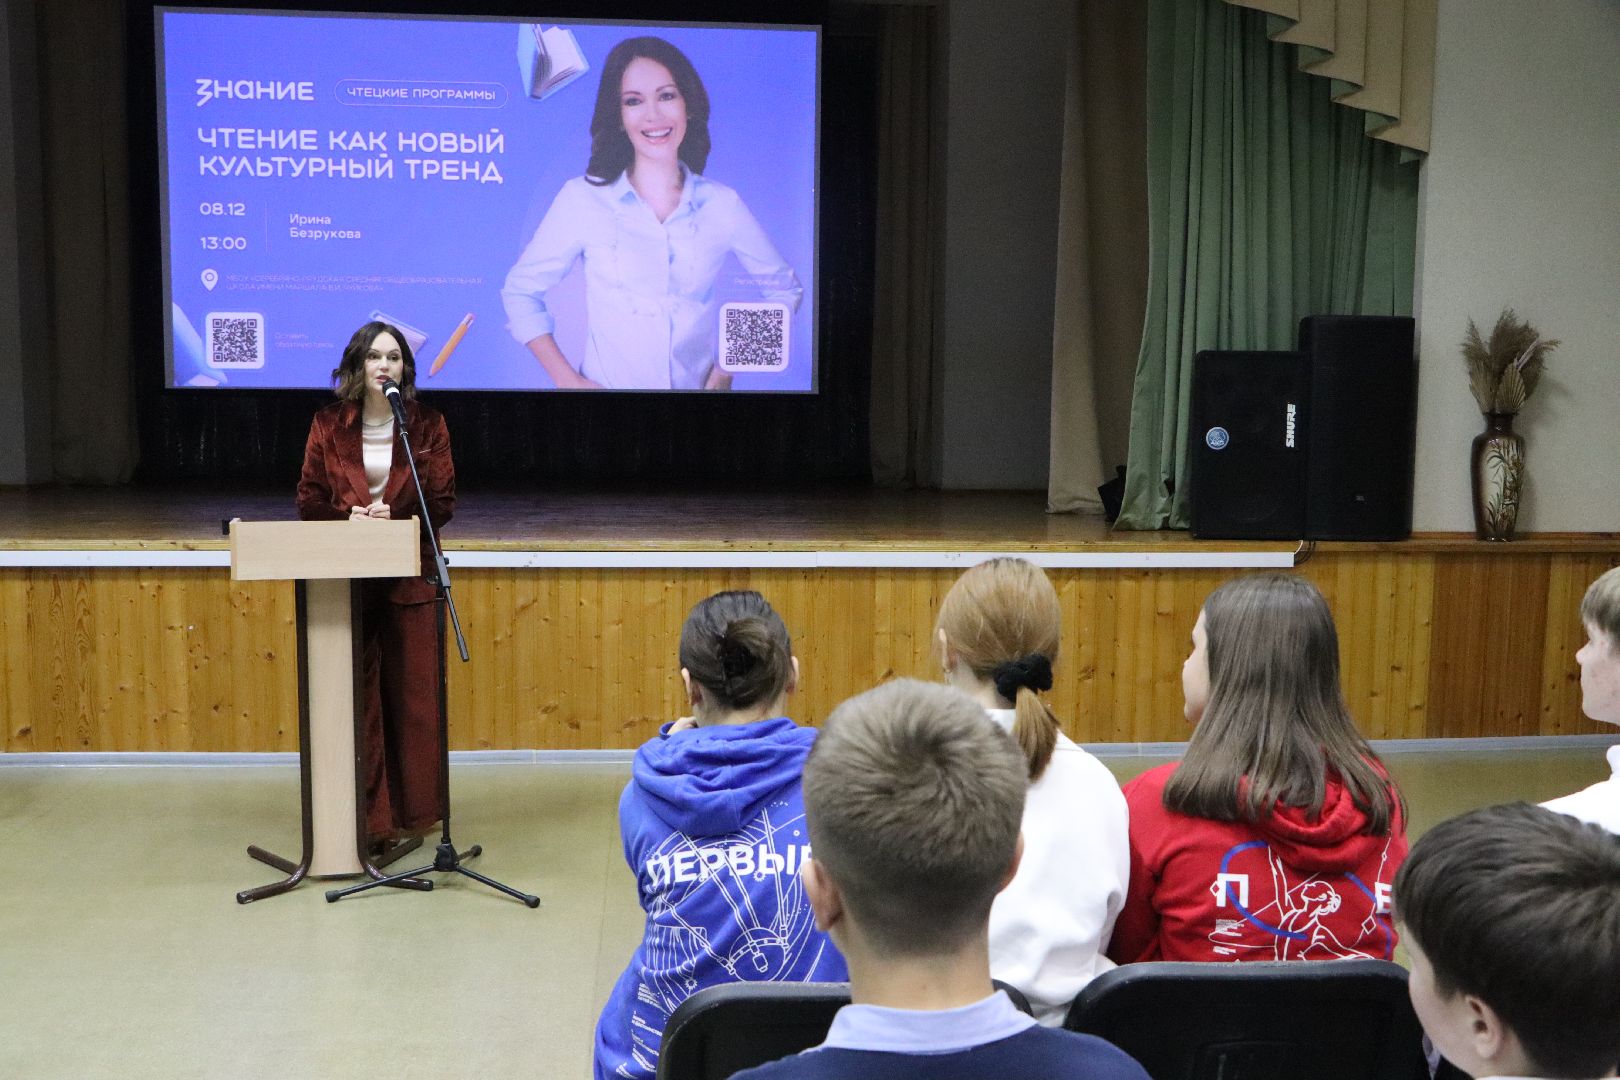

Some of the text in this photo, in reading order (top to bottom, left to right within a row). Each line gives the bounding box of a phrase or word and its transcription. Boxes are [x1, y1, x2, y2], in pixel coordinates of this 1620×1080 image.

[347, 87, 496, 100] ЧТЕЦКИЕ ПРОГРАММЫ
[197, 127, 504, 154] ЧТЕНИЕ КАК НОВЫЙ
[199, 153, 504, 184] КУЛЬТУРНЫЙ ТРЕНД
[200, 202, 246, 216] 08.12
[289, 213, 332, 226] Ирина
[289, 227, 361, 241] Безрукова
[200, 236, 247, 250] 13:00
[1286, 403, 1296, 448] SHURE
